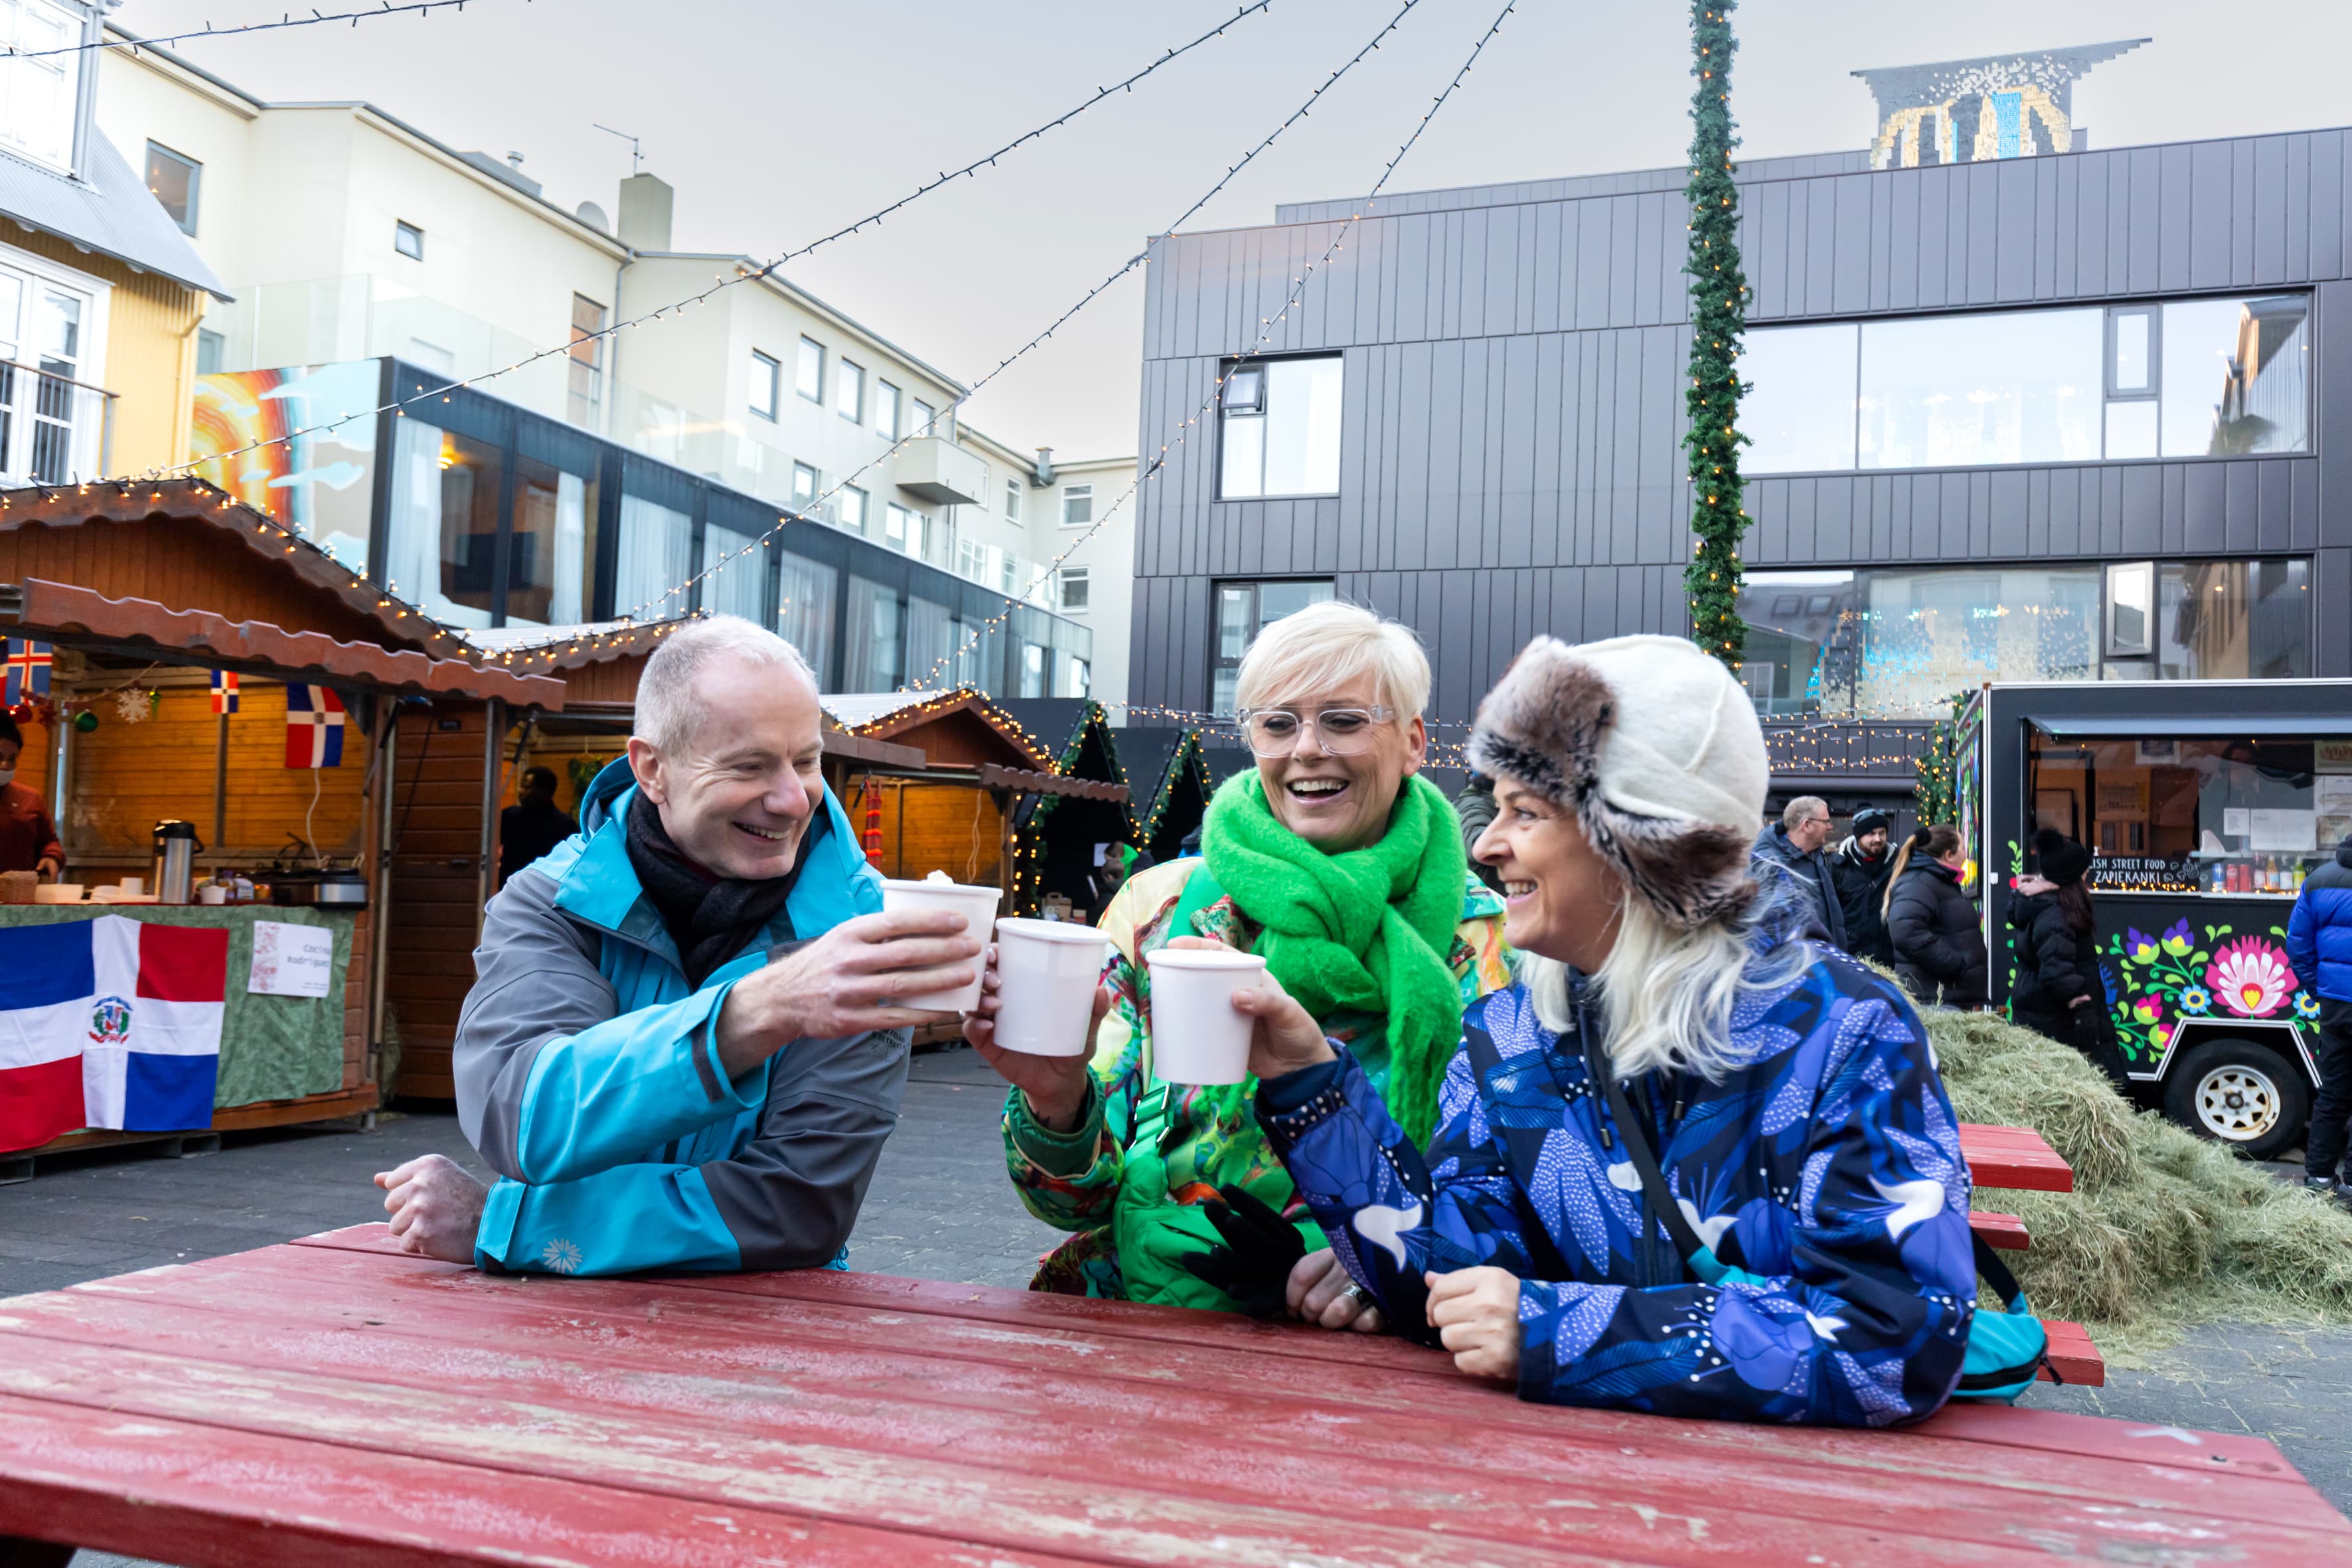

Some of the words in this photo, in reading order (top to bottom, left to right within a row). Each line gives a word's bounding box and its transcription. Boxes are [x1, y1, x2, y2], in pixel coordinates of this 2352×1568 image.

[2112, 858, 2140, 869] STREET
[2145, 858, 2165, 870] FOOD
[2095, 870, 2160, 883] ZAPIEKANKI
